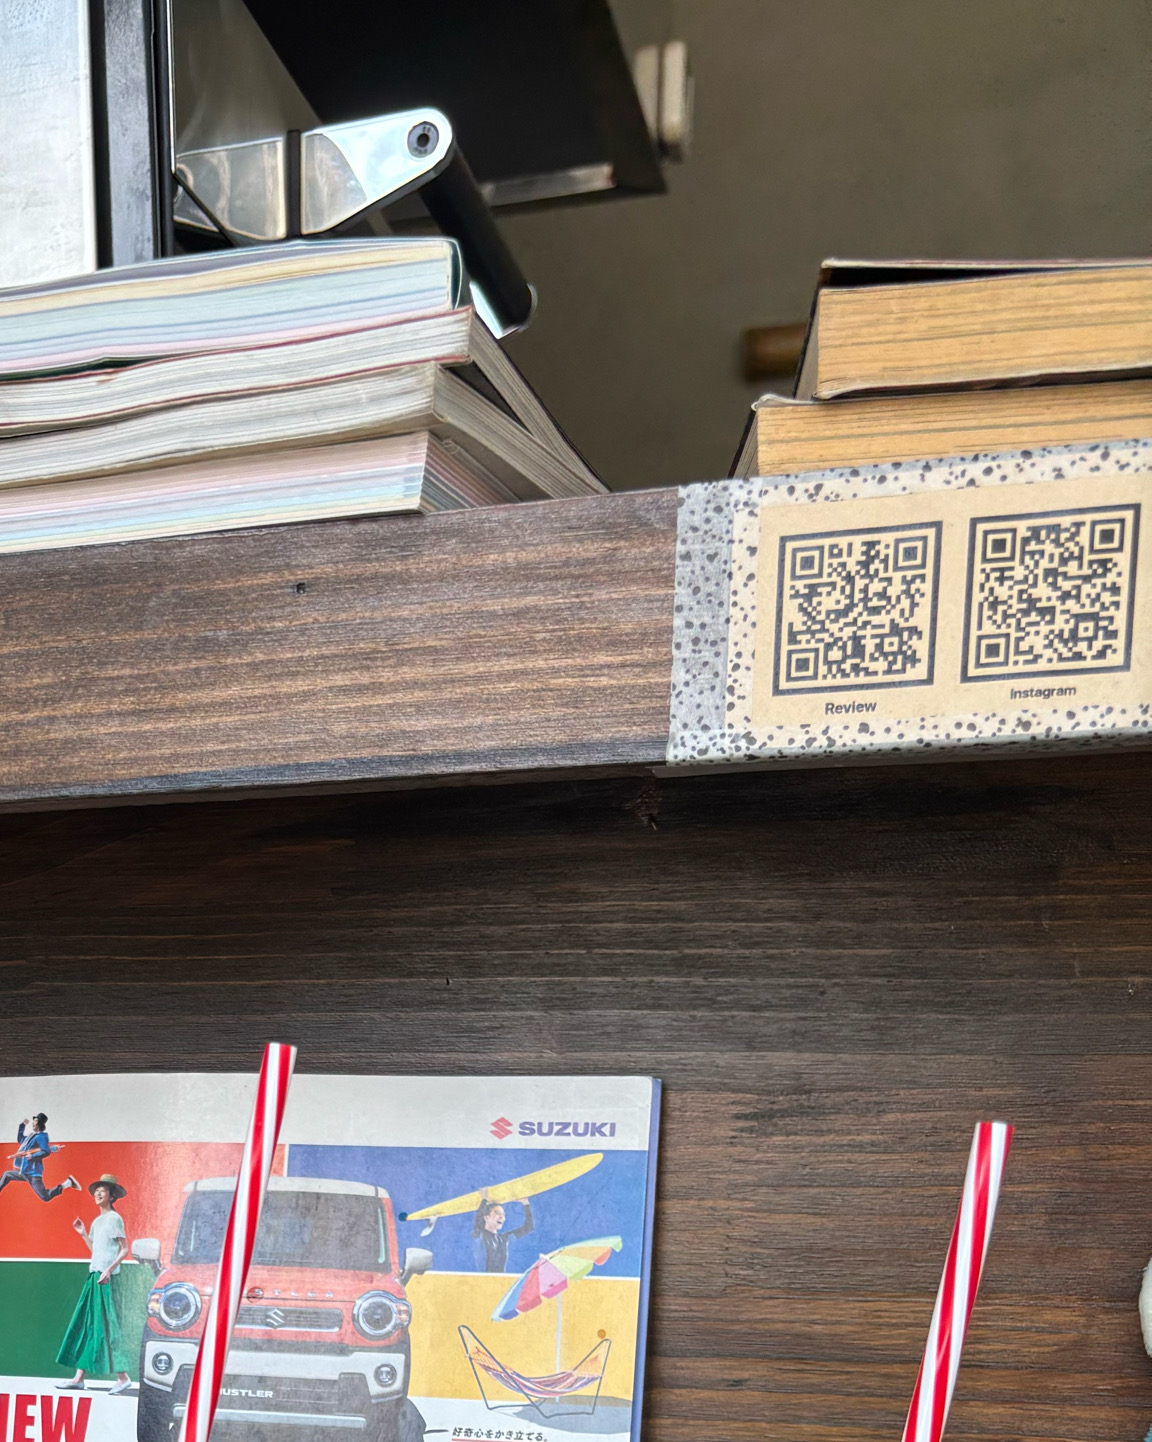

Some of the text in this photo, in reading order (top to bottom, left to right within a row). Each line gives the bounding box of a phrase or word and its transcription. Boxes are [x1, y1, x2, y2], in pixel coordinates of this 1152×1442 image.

[1009, 684, 1077, 701] Instagram
[824, 699, 877, 716] Review
[518, 1121, 617, 1137] SUZUKI
[452, 1427, 548, 1442] 好奇心をかき立てる。
